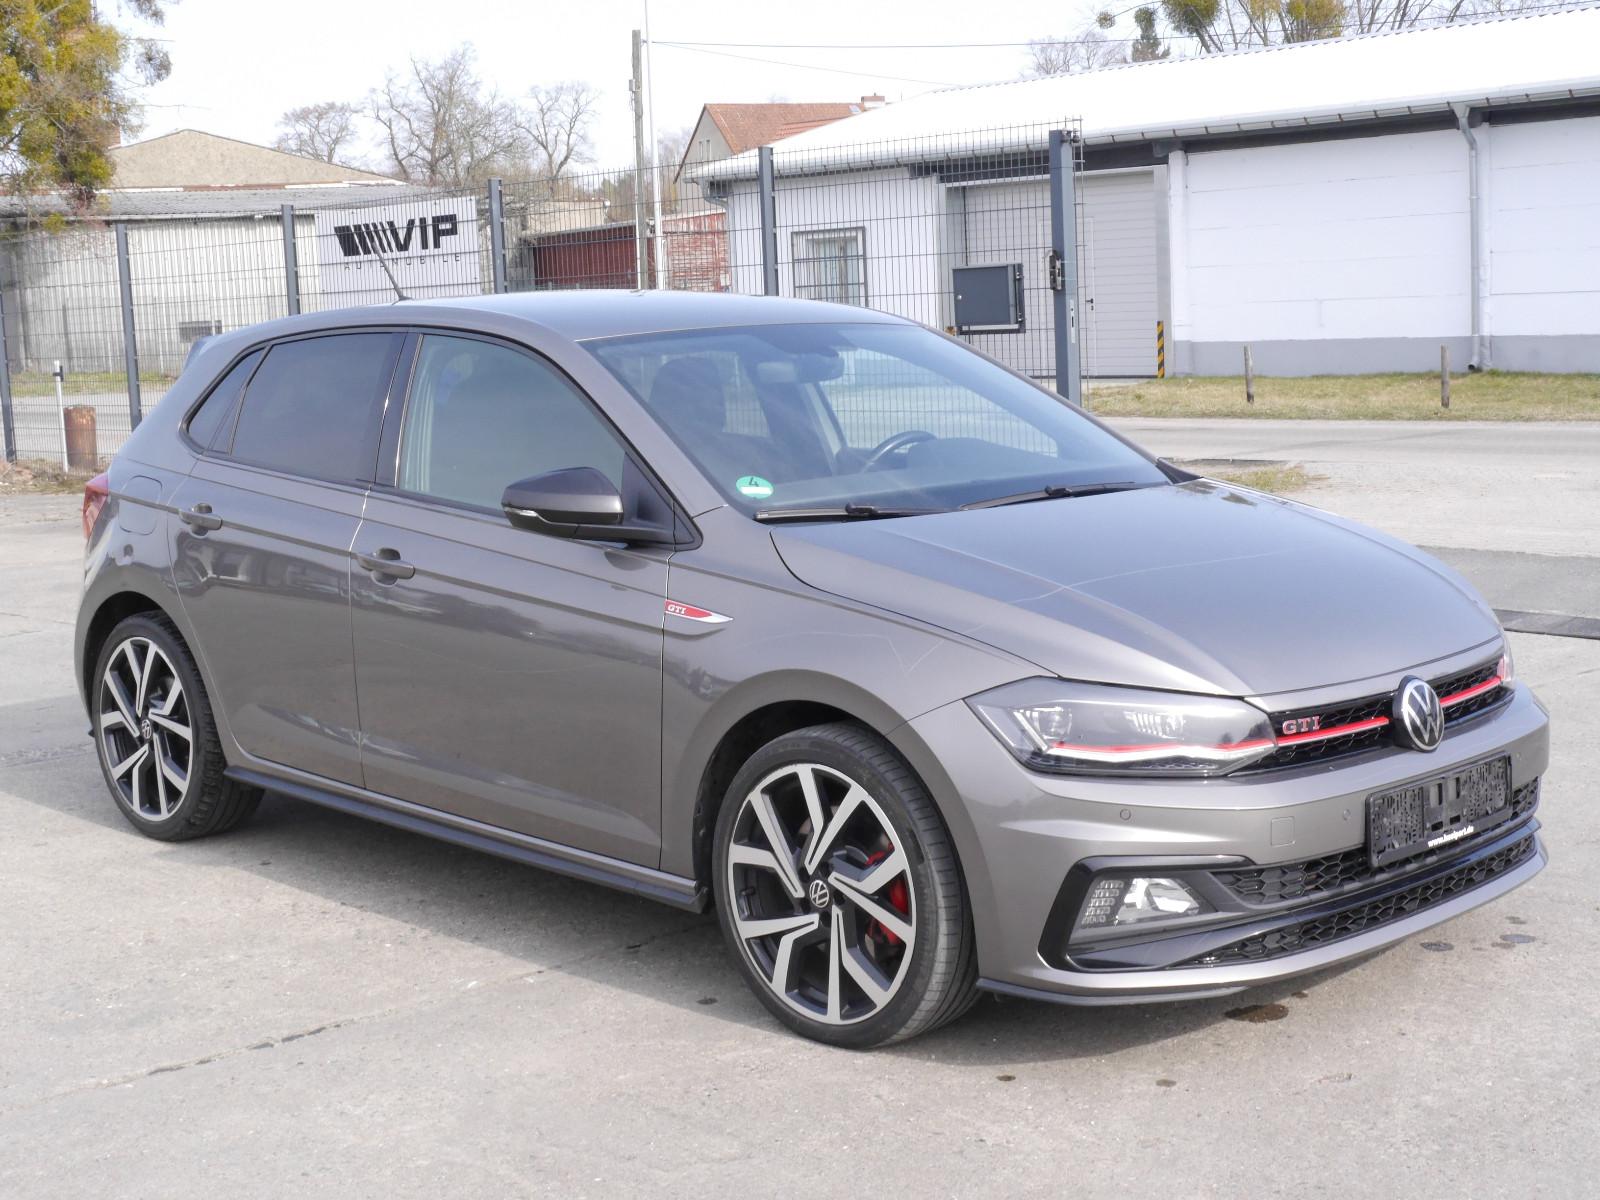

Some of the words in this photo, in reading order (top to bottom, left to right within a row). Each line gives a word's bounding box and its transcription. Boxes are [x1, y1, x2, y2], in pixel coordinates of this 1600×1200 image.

[386, 214, 458, 252] VIP
[748, 476, 760, 487] 4
[667, 604, 687, 615] GTI
[1282, 715, 1321, 735] GTI
